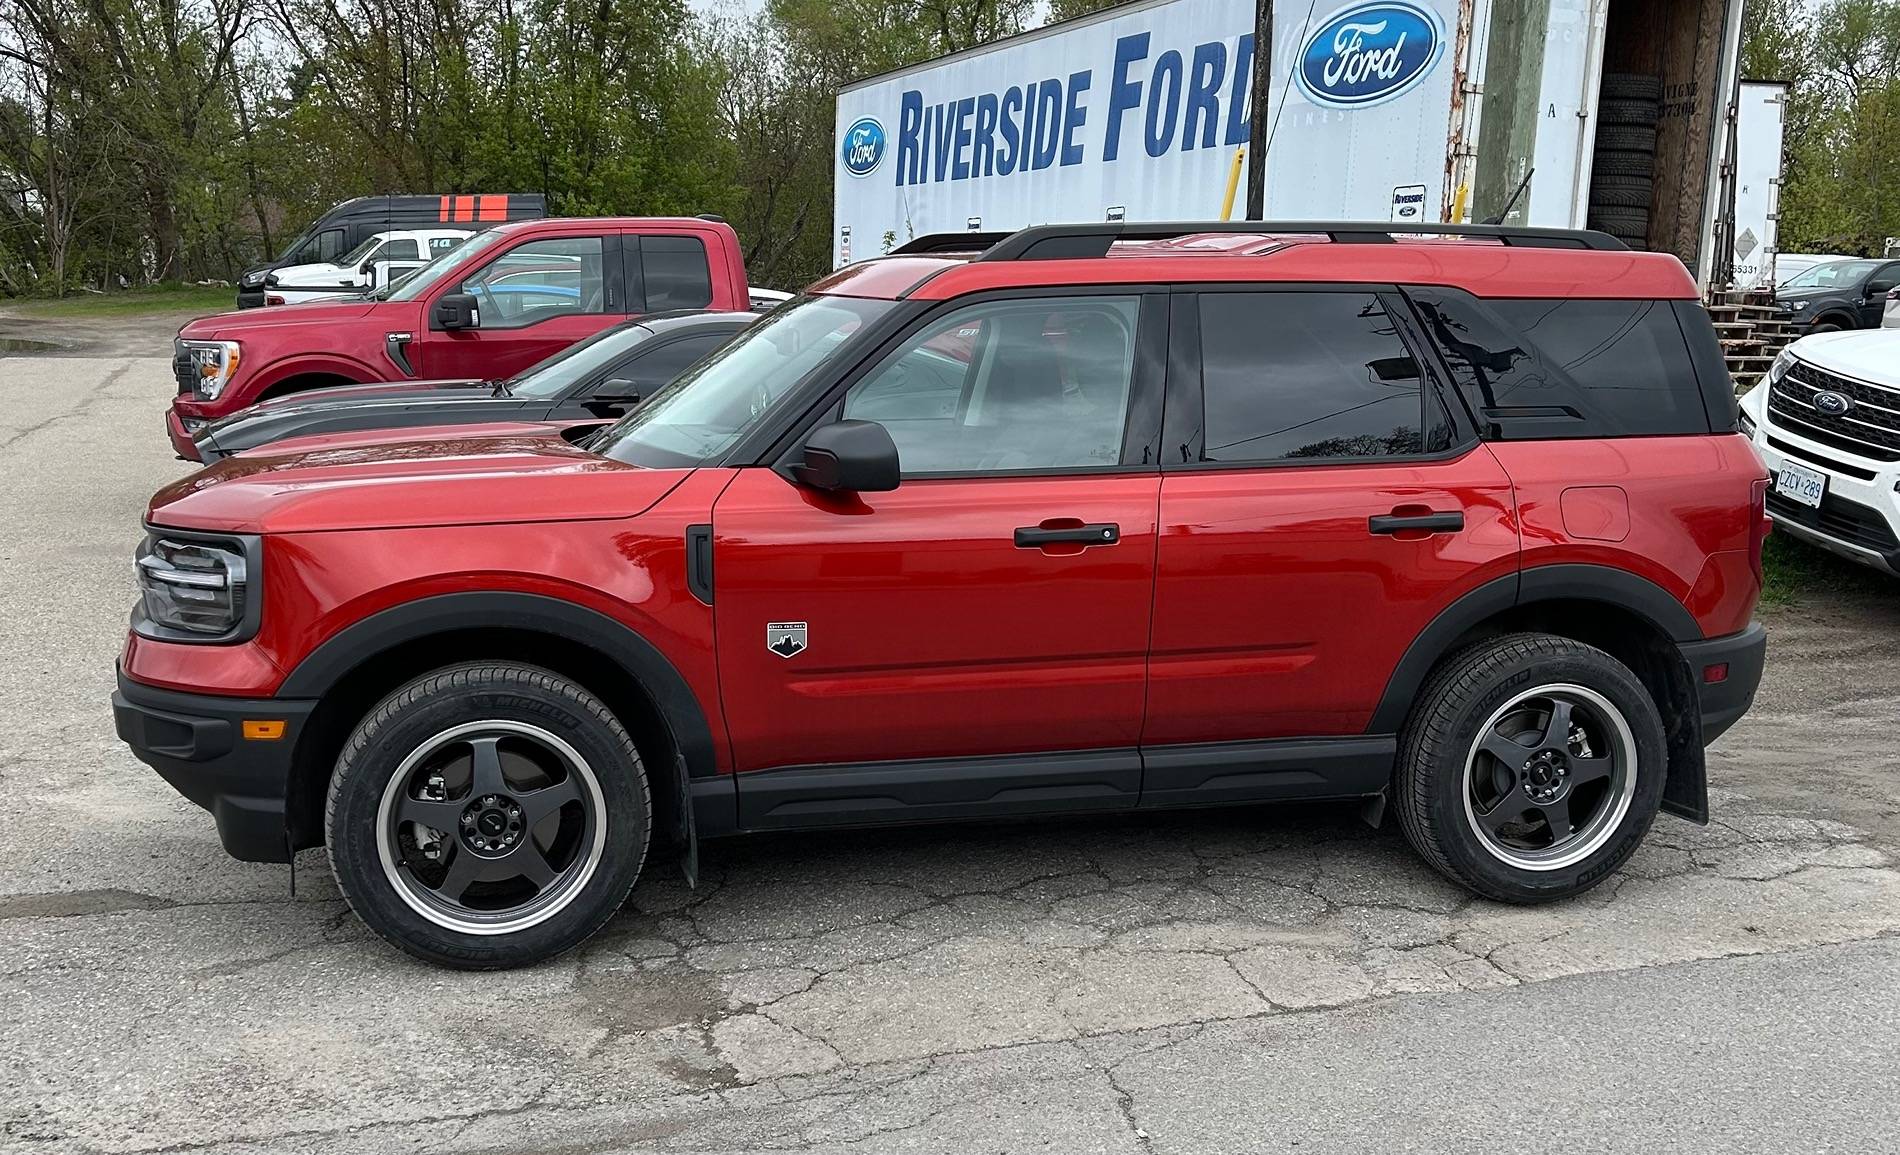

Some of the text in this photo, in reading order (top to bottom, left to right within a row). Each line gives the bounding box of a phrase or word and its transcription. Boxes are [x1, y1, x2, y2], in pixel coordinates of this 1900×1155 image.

[1324, 20, 1408, 87] Ford
[896, 69, 1092, 187] RIVERSIDE
[1547, 103, 1556, 118] A
[849, 128, 877, 165] Ford
[1395, 193, 1424, 204] RIVERSIDE
